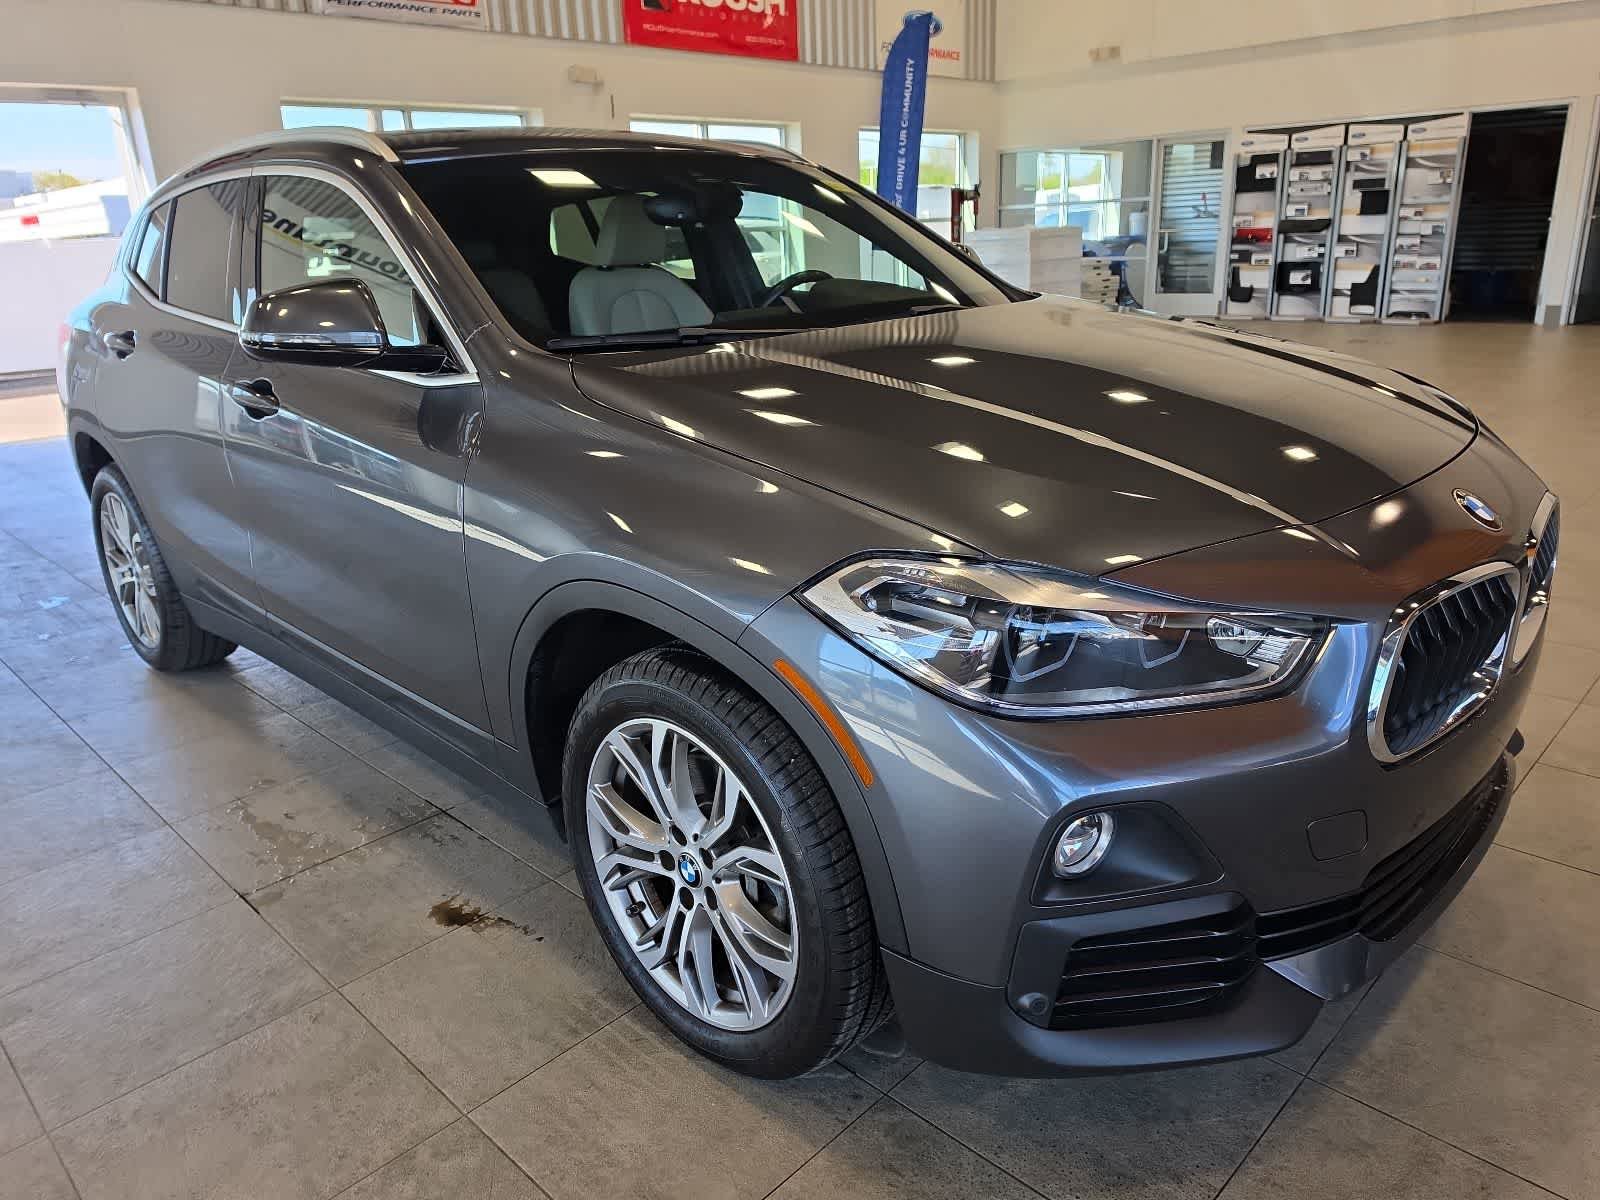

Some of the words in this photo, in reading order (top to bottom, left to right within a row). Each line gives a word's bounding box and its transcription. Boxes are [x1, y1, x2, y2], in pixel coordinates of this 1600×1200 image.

[441, 8, 481, 17] PARTS
[901, 58, 915, 127] COMMUNITY
[899, 129, 908, 146] UR
[896, 158, 906, 190] DRIVE
